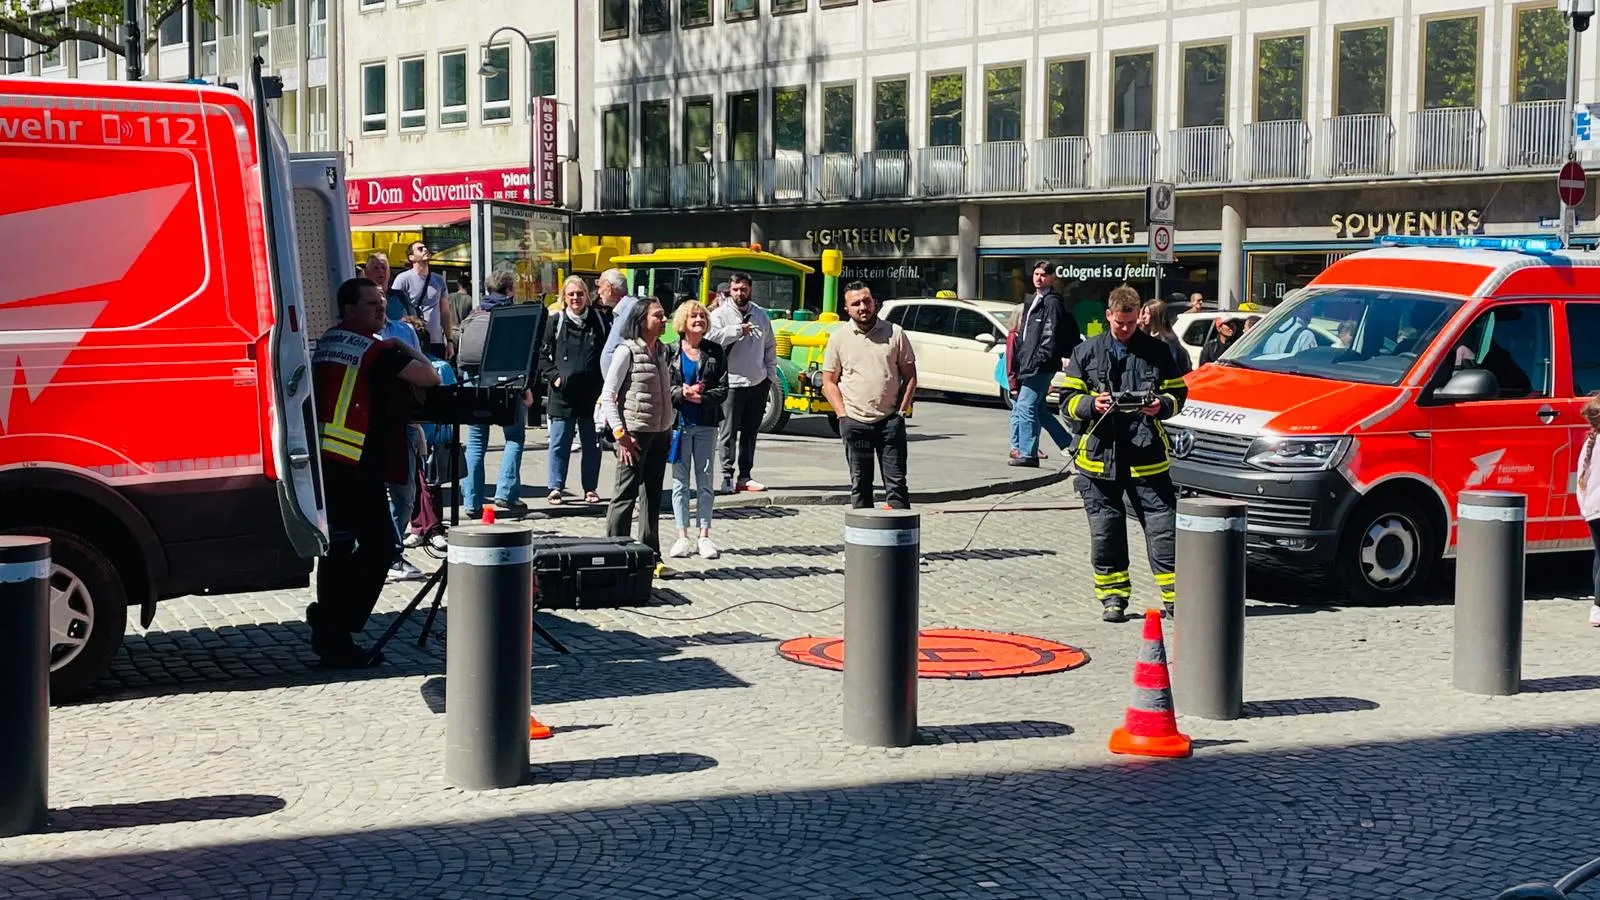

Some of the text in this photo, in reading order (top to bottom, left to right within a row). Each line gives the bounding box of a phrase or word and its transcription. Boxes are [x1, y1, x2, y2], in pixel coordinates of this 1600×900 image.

[137, 116, 198, 145] 112
[543, 113, 554, 199] SOUVENIRS
[367, 177, 484, 205] Dom Souvenirs
[505, 190, 518, 199] FREE
[1052, 221, 1131, 241] SERVICE
[1331, 209, 1480, 234] SOUVENIRS
[806, 227, 910, 245] SIGHTSEEING
[840, 265, 920, 281] öln ist ein Gefühl.
[1055, 264, 1167, 280] Cologne is a feelin.
[1179, 405, 1246, 425] ERWEHR
